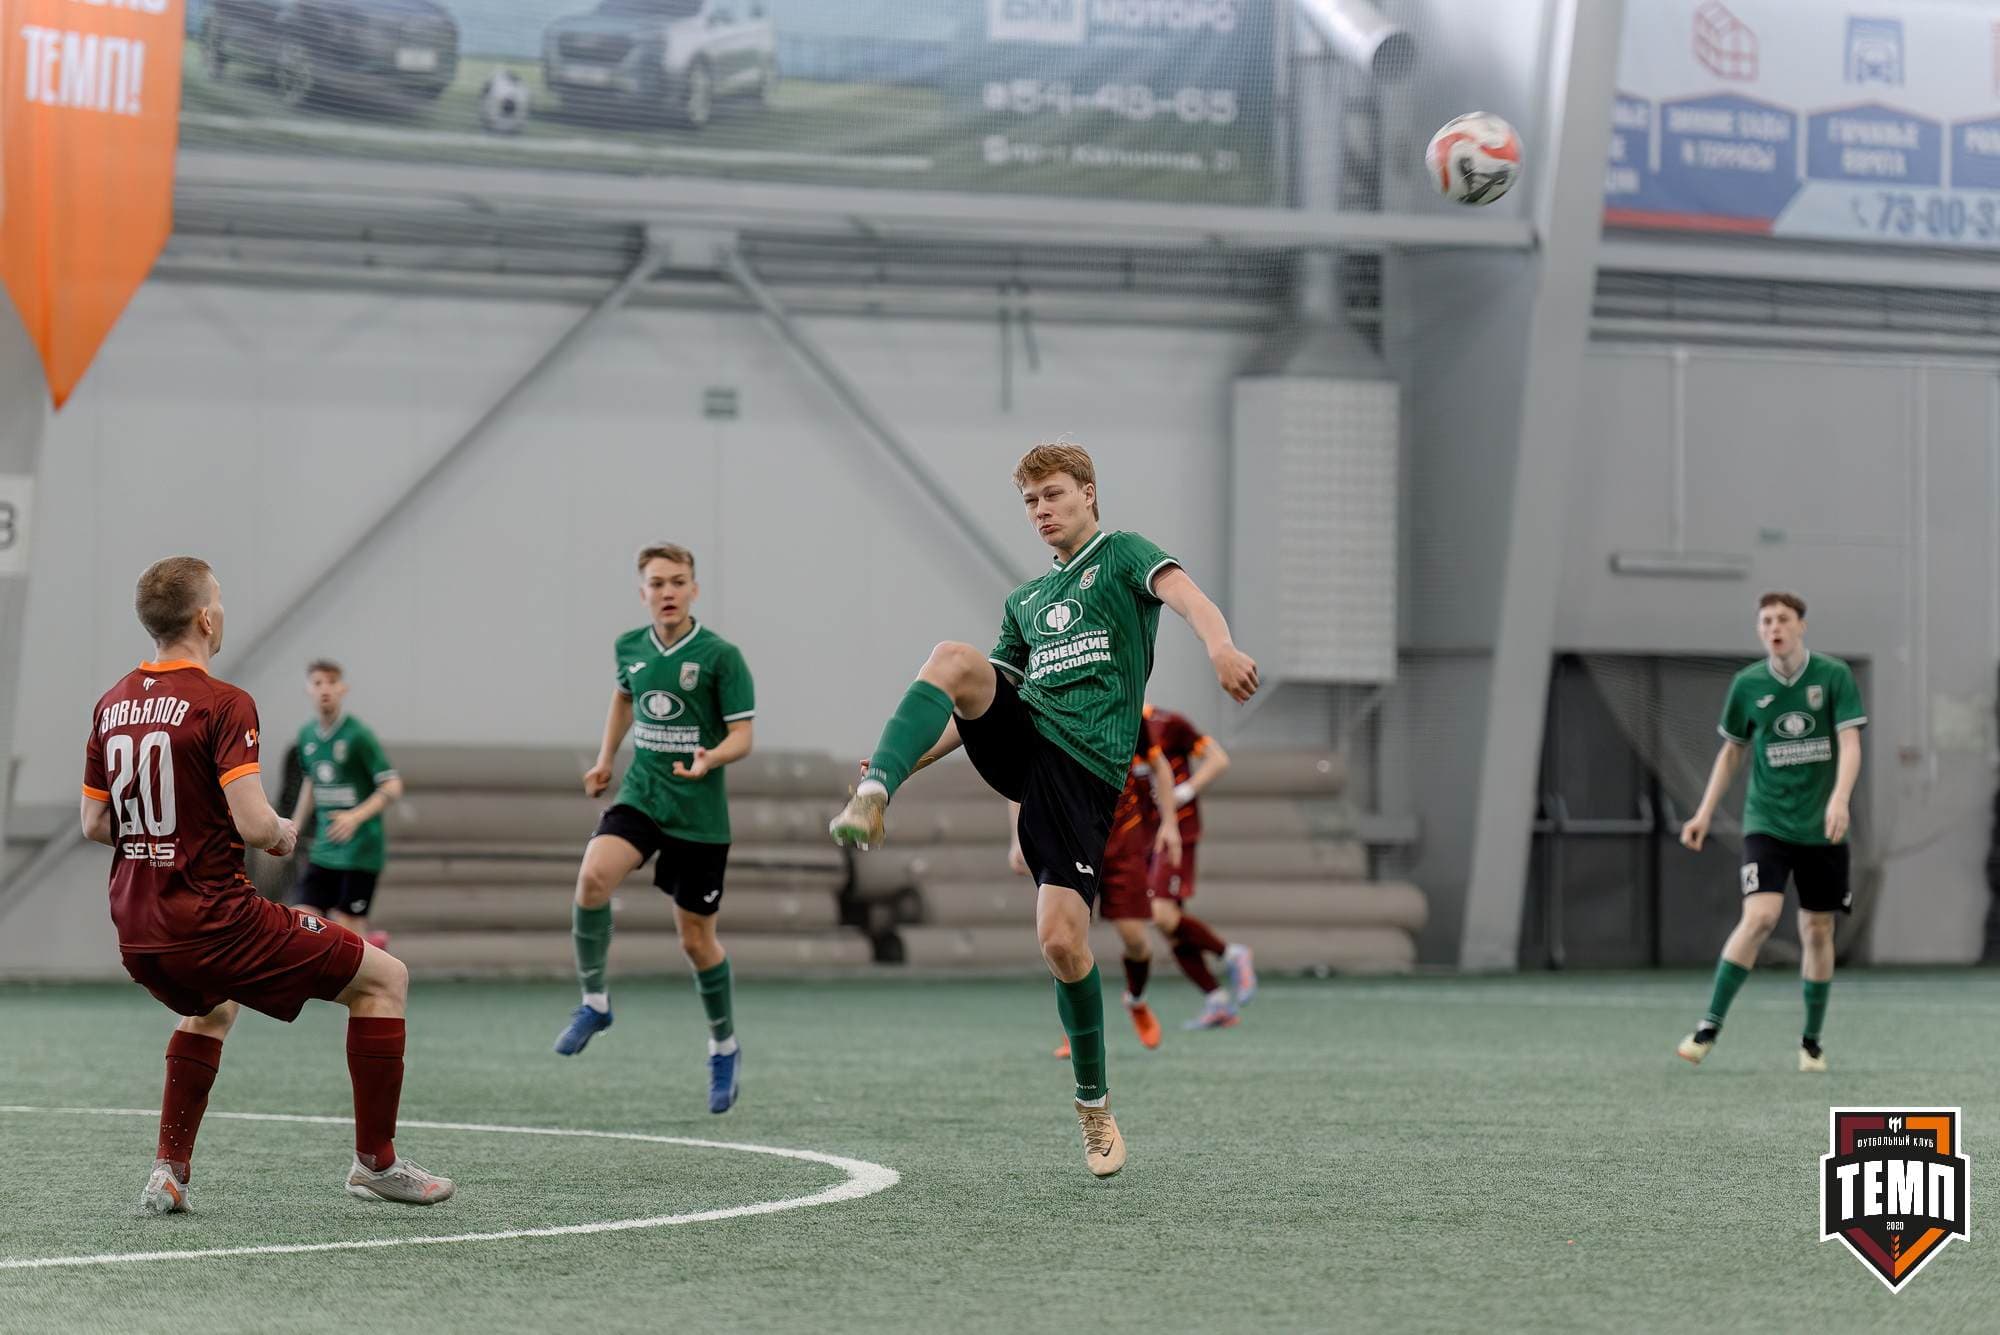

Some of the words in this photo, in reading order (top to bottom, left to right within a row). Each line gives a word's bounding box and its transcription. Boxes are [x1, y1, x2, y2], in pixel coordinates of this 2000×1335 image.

[20, 24, 144, 117] ТЕМП!
[1876, 191, 2000, 238] 73-00-3
[1029, 651, 1111, 680] ФРРОСПЛАВЫ
[101, 696, 189, 734] ЗАВЬЯЛОВ
[106, 731, 177, 838] 20
